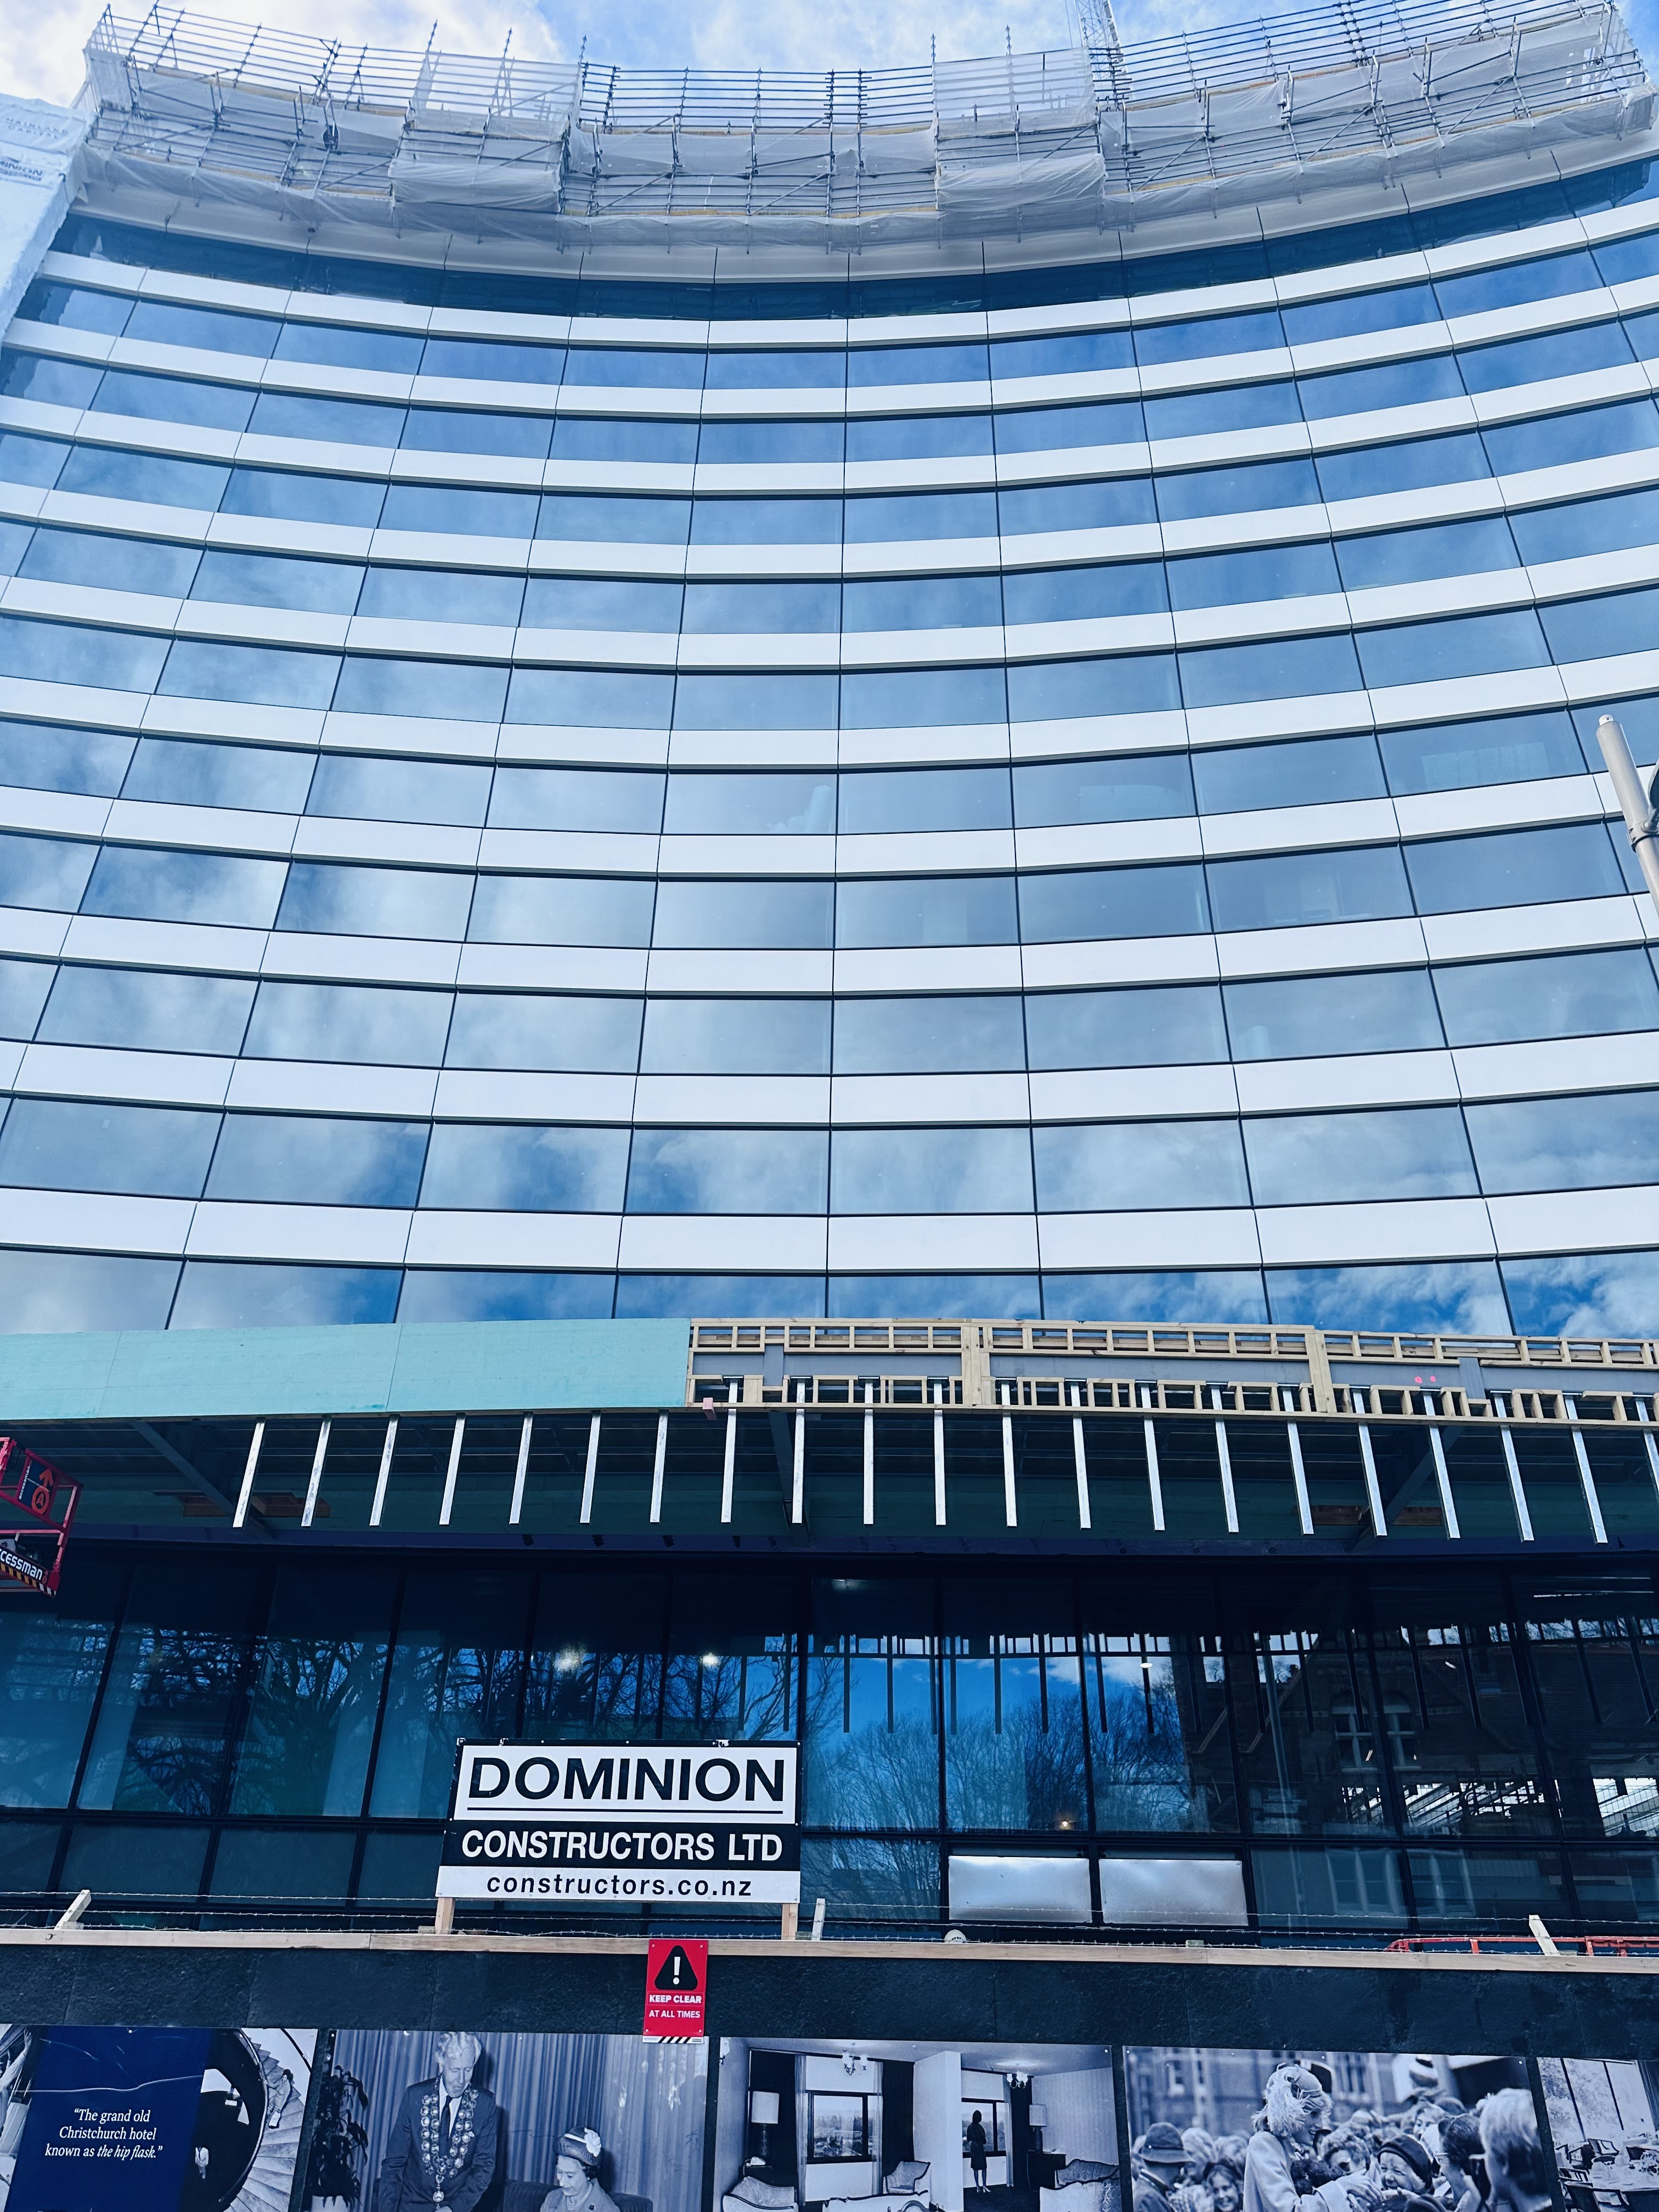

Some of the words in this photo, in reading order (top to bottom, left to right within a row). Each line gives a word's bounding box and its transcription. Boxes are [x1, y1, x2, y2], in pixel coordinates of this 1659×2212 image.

[0, 1549, 42, 1580] cessman
[468, 1756, 785, 1802] DOMINION
[461, 1830, 715, 1861] CONSTRUCTORS
[729, 1833, 783, 1861] LTD
[486, 1874, 753, 1897] constructors.co.nz
[74, 2107, 98, 2121] “The
[99, 2109, 132, 2124] grand
[133, 2109, 151, 2122] old
[59, 2125, 127, 2139] Christchurch
[129, 2127, 157, 2140] hotel
[44, 2143, 80, 2156] known
[83, 2147, 95, 2157] as
[97, 2145, 113, 2157] the
[114, 2145, 131, 2160] hip
[130, 2145, 163, 2160] flask.”
